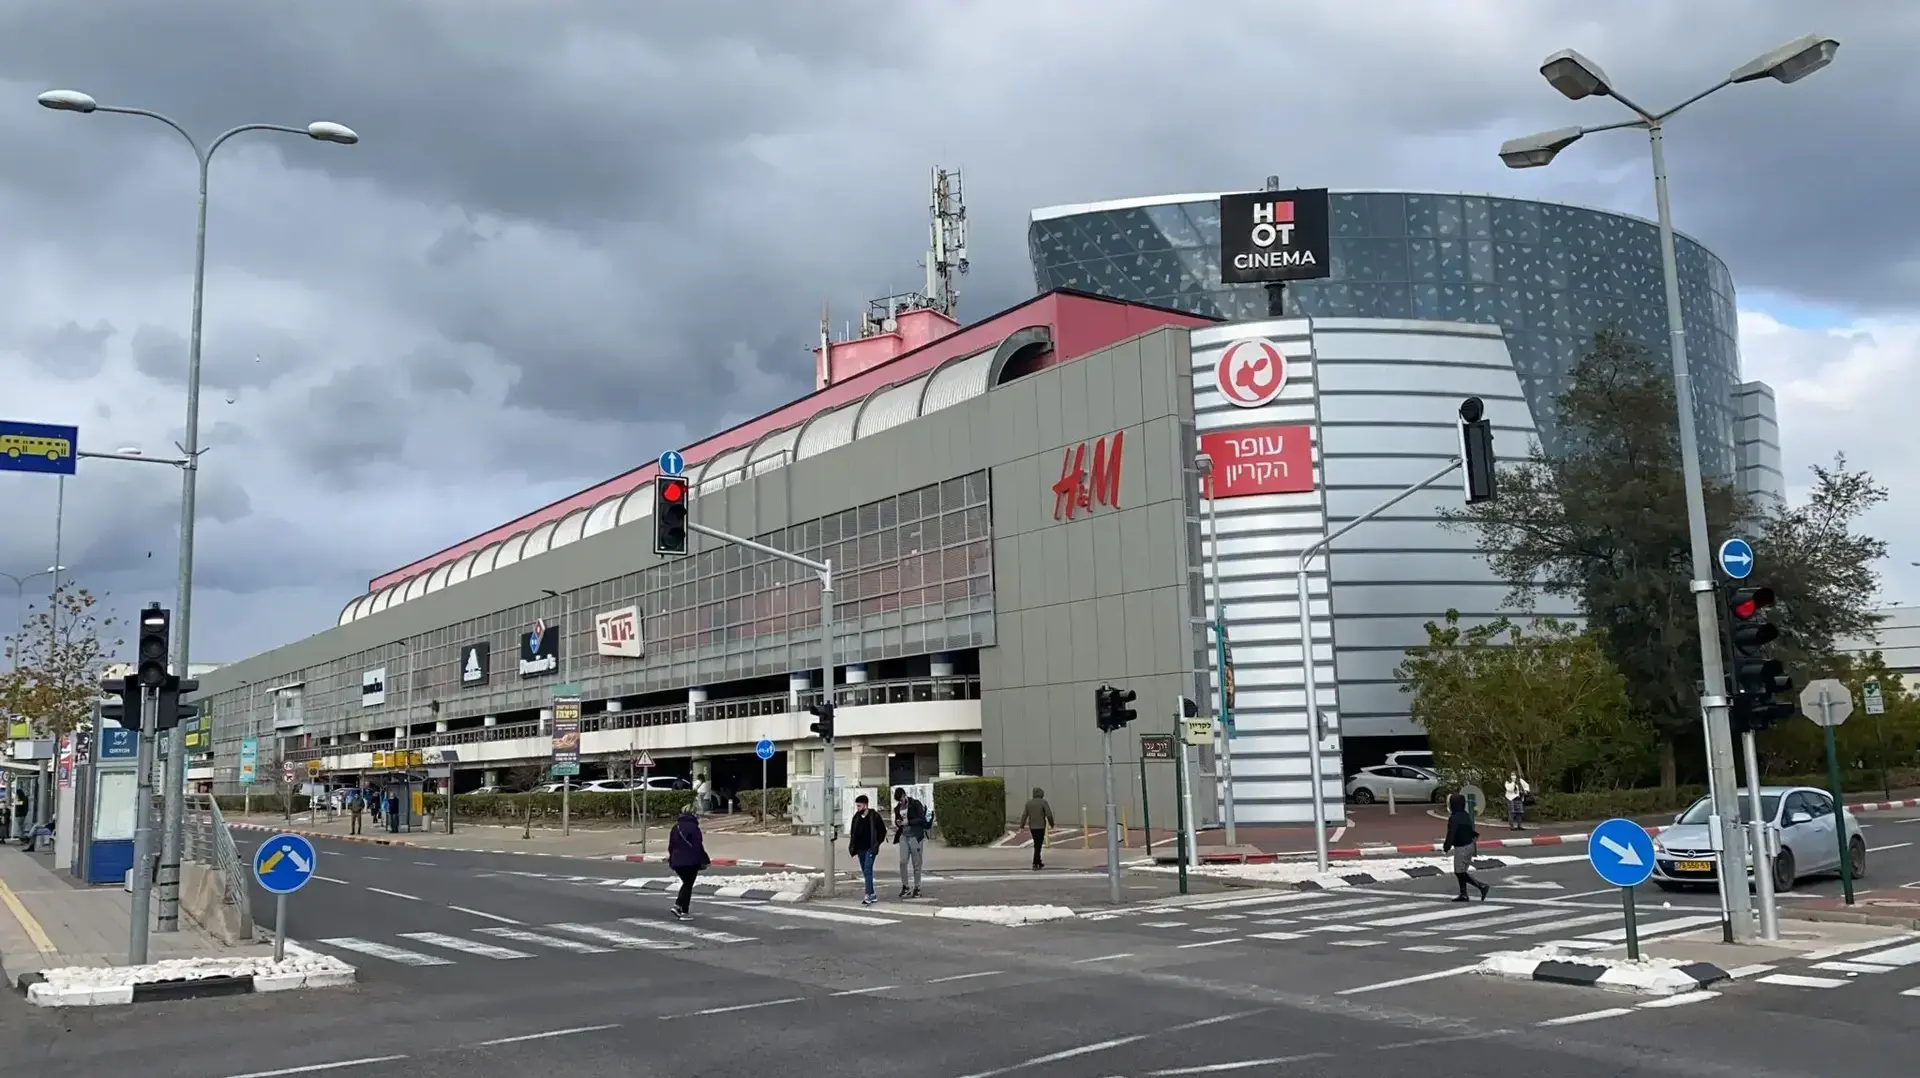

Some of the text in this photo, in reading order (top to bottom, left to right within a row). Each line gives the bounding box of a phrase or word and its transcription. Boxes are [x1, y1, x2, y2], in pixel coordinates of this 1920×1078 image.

[1234, 250, 1316, 271] CINEMA
[1225, 435, 1283, 458] עופר
[1052, 430, 1124, 520] H&M
[1225, 459, 1288, 488] הקריון
[1189, 722, 1211, 730] לקריון
